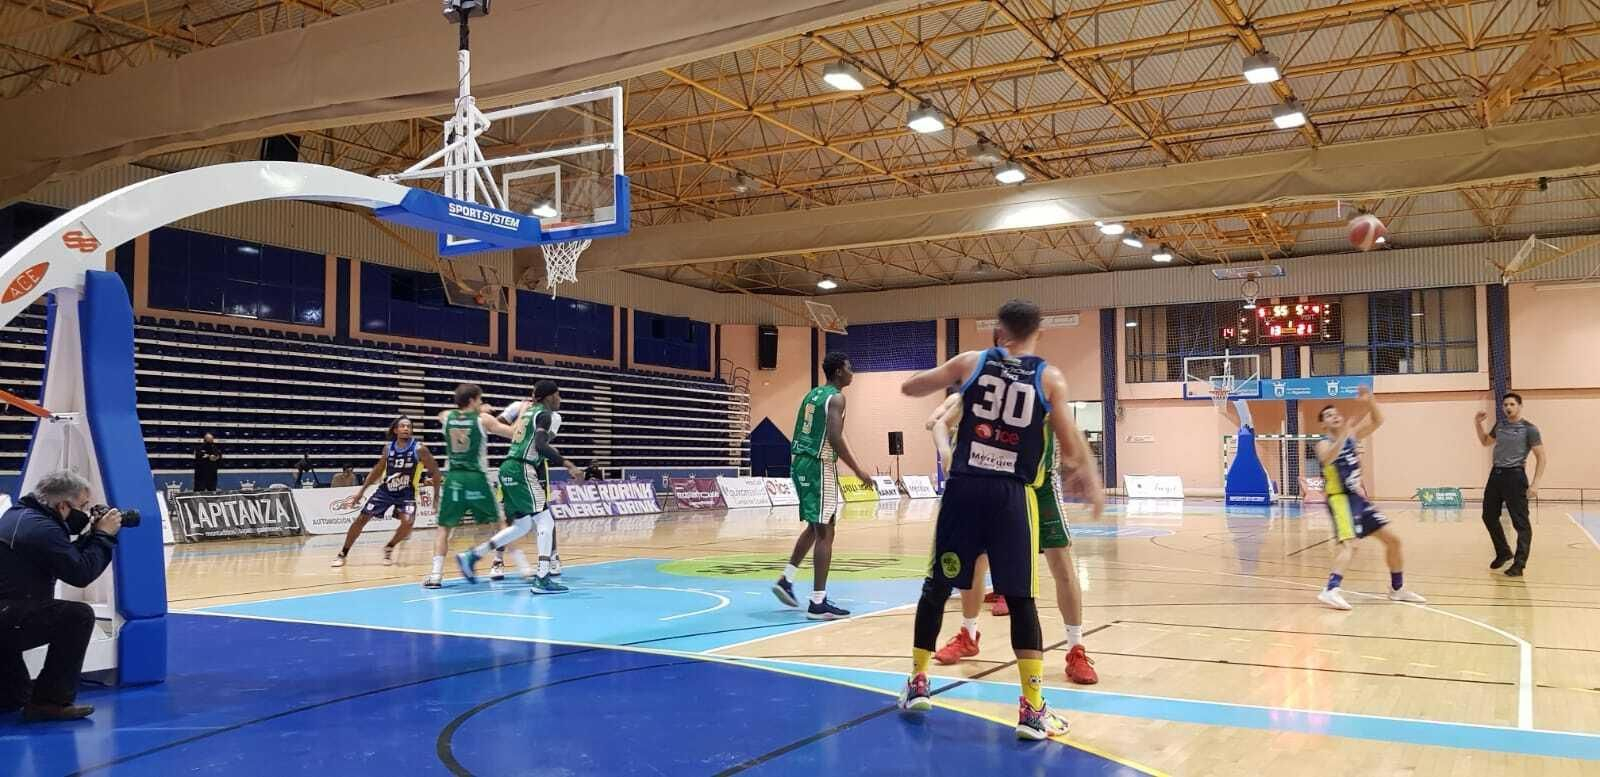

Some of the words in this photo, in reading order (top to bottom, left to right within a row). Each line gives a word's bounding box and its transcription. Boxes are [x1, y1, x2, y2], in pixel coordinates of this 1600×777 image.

[10, 269, 41, 299] ACE
[972, 374, 1035, 428] 30
[802, 402, 816, 434] 5
[394, 458, 405, 468] 13
[566, 483, 655, 501] ENERDRINK
[184, 498, 291, 529] LAPITANZA
[551, 502, 613, 519] ENERGY
[614, 500, 660, 514] DRINK
